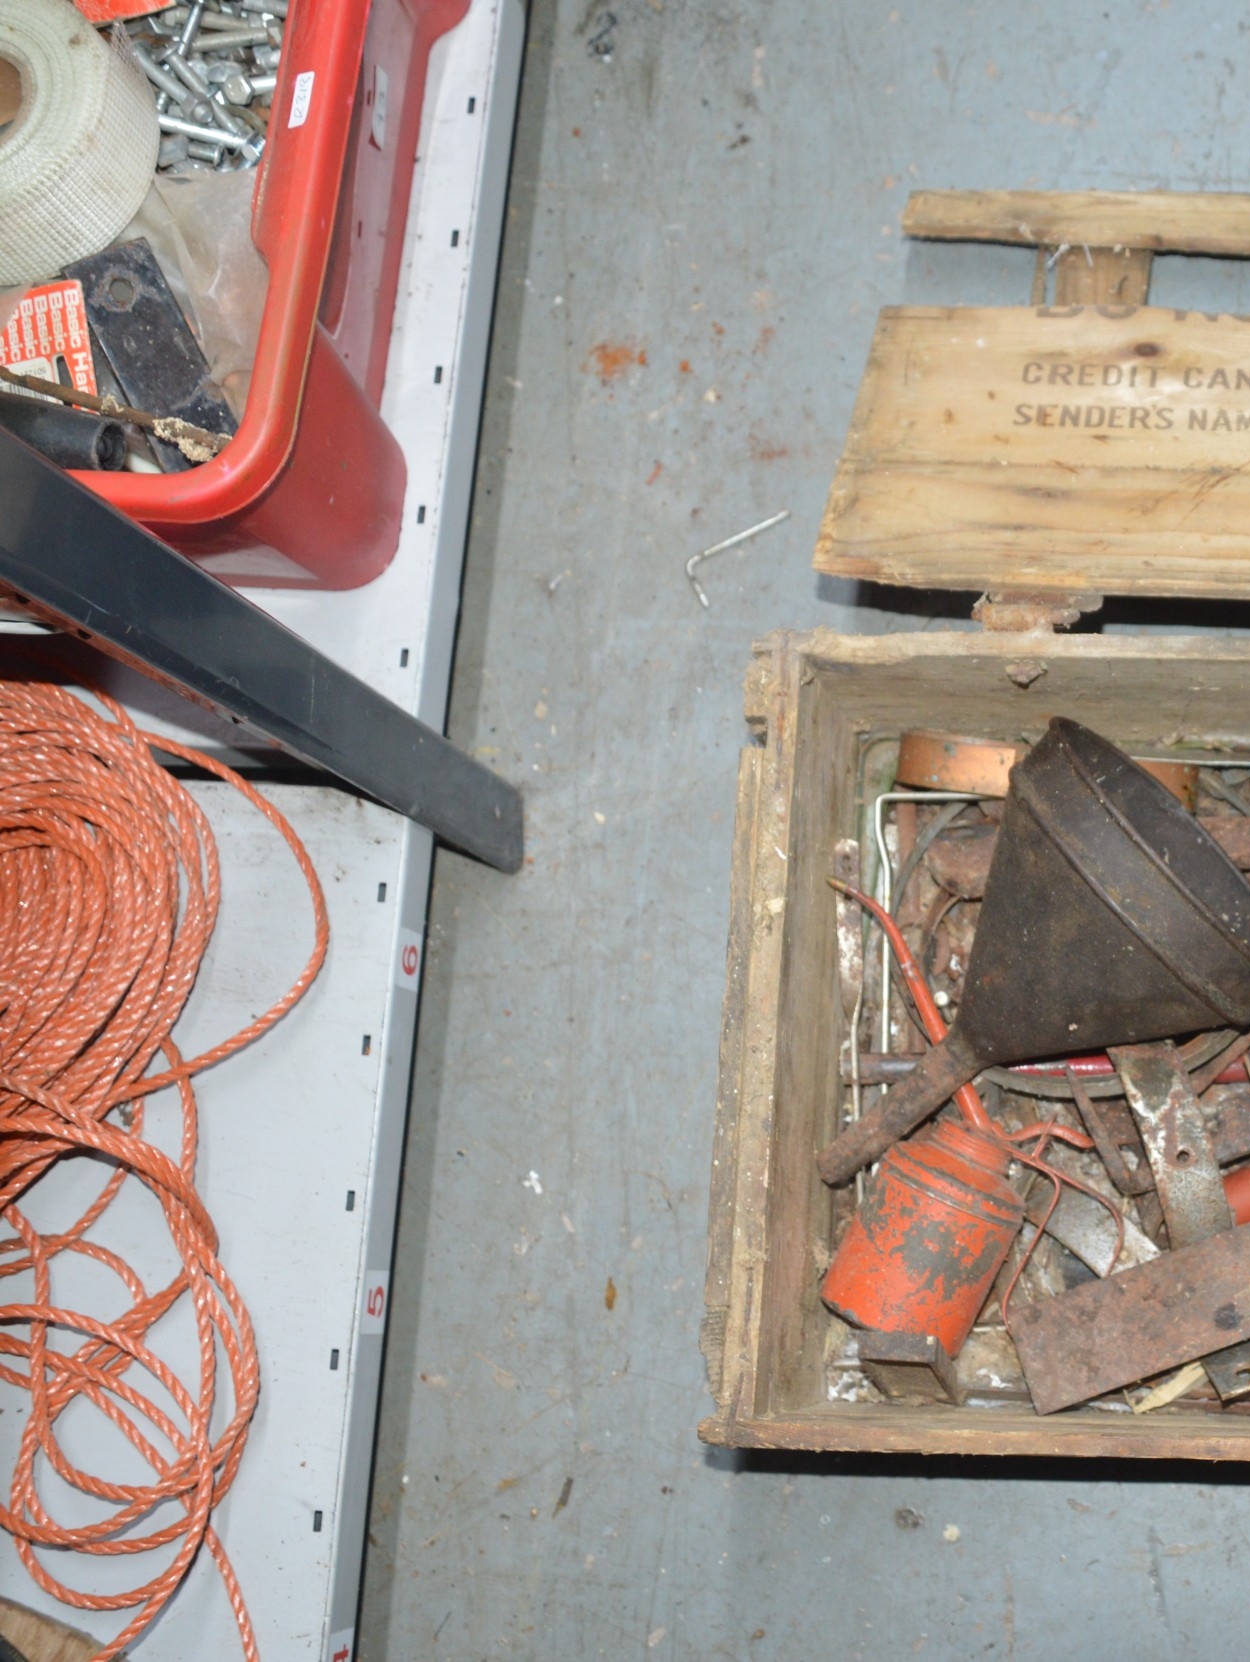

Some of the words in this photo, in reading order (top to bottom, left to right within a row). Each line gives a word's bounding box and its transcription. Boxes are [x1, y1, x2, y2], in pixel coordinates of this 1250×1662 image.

[20, 299, 38, 359] Basic
[33, 295, 52, 355] Basic
[48, 291, 68, 352] Basic
[64, 289, 83, 349] Basic
[72, 352, 90, 396] Har
[1021, 361, 1167, 388] CREDIT
[1012, 403, 1174, 429] SENDER'S
[402, 944, 418, 976] 6
[367, 1286, 384, 1318] 5
